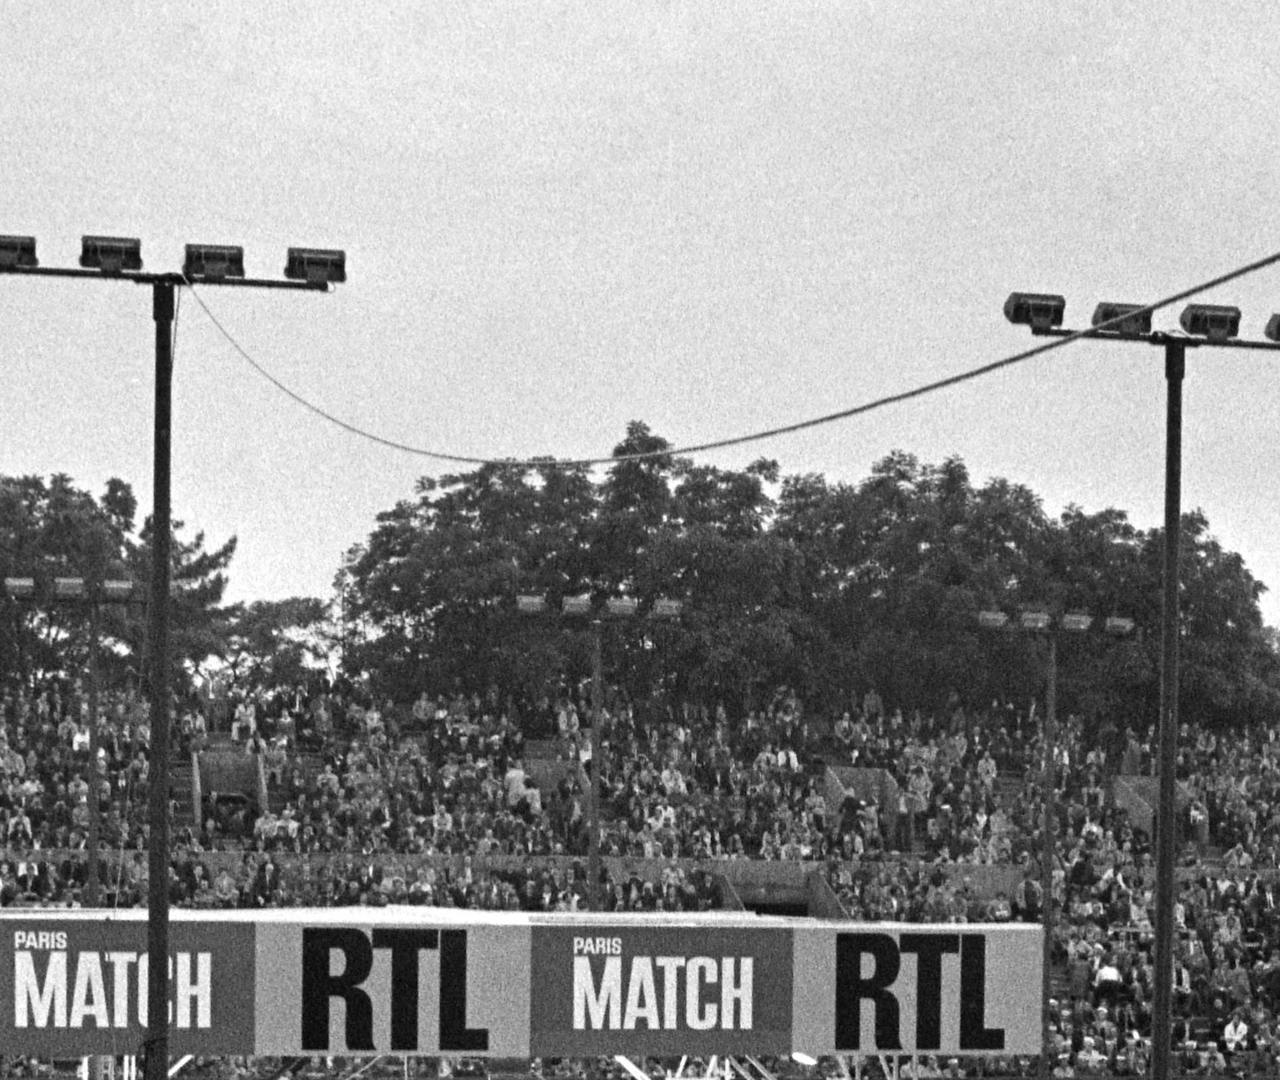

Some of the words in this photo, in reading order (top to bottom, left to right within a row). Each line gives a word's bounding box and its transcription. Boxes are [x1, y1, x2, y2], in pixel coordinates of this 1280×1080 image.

[14, 931, 68, 949] PARIS
[573, 937, 623, 954] PARIS
[302, 927, 489, 1051] RTL
[573, 955, 754, 1030] MATCH
[835, 932, 1005, 1050] RTL
